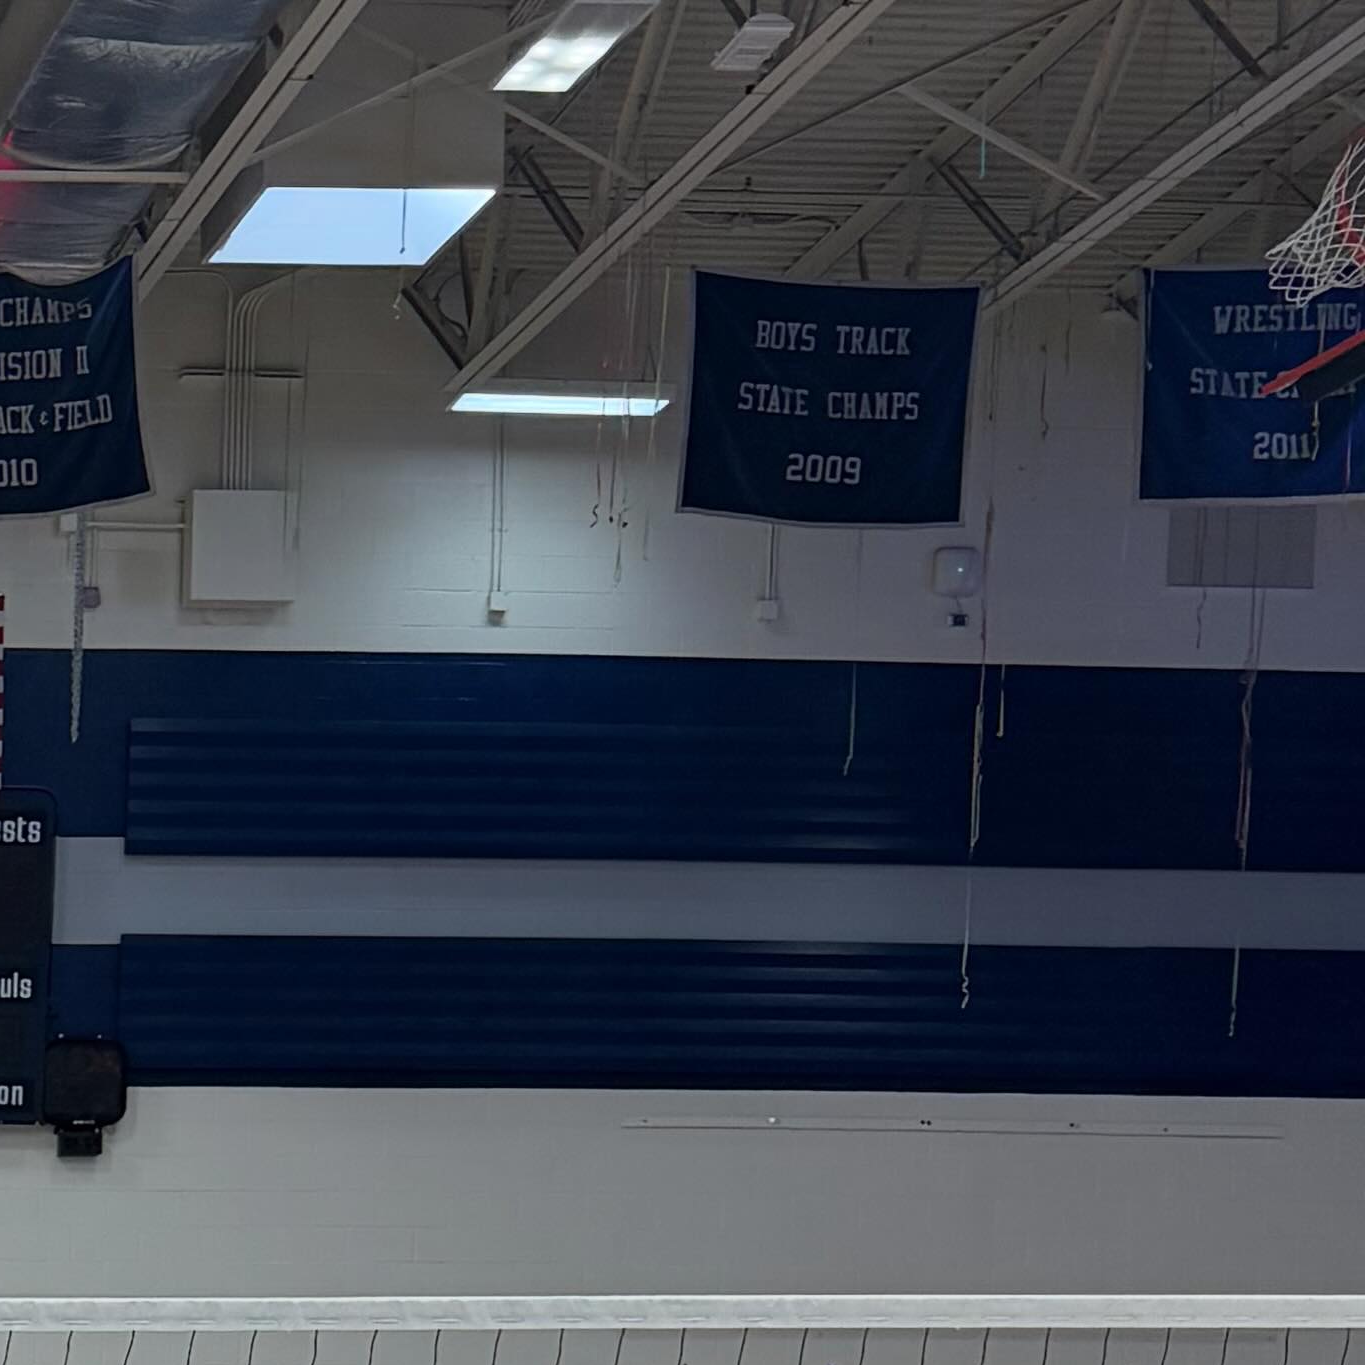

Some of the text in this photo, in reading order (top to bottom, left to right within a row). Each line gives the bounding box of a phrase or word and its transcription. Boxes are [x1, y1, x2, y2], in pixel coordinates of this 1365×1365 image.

[1213, 303, 1358, 334] WRESTLING
[755, 320, 911, 355] BOYS TRACK
[76, 345, 90, 375] II
[1190, 367, 1267, 399] STATE
[53, 393, 113, 432] FIELD
[737, 382, 920, 420] STATE CHAMPS
[785, 453, 862, 485] 2009
